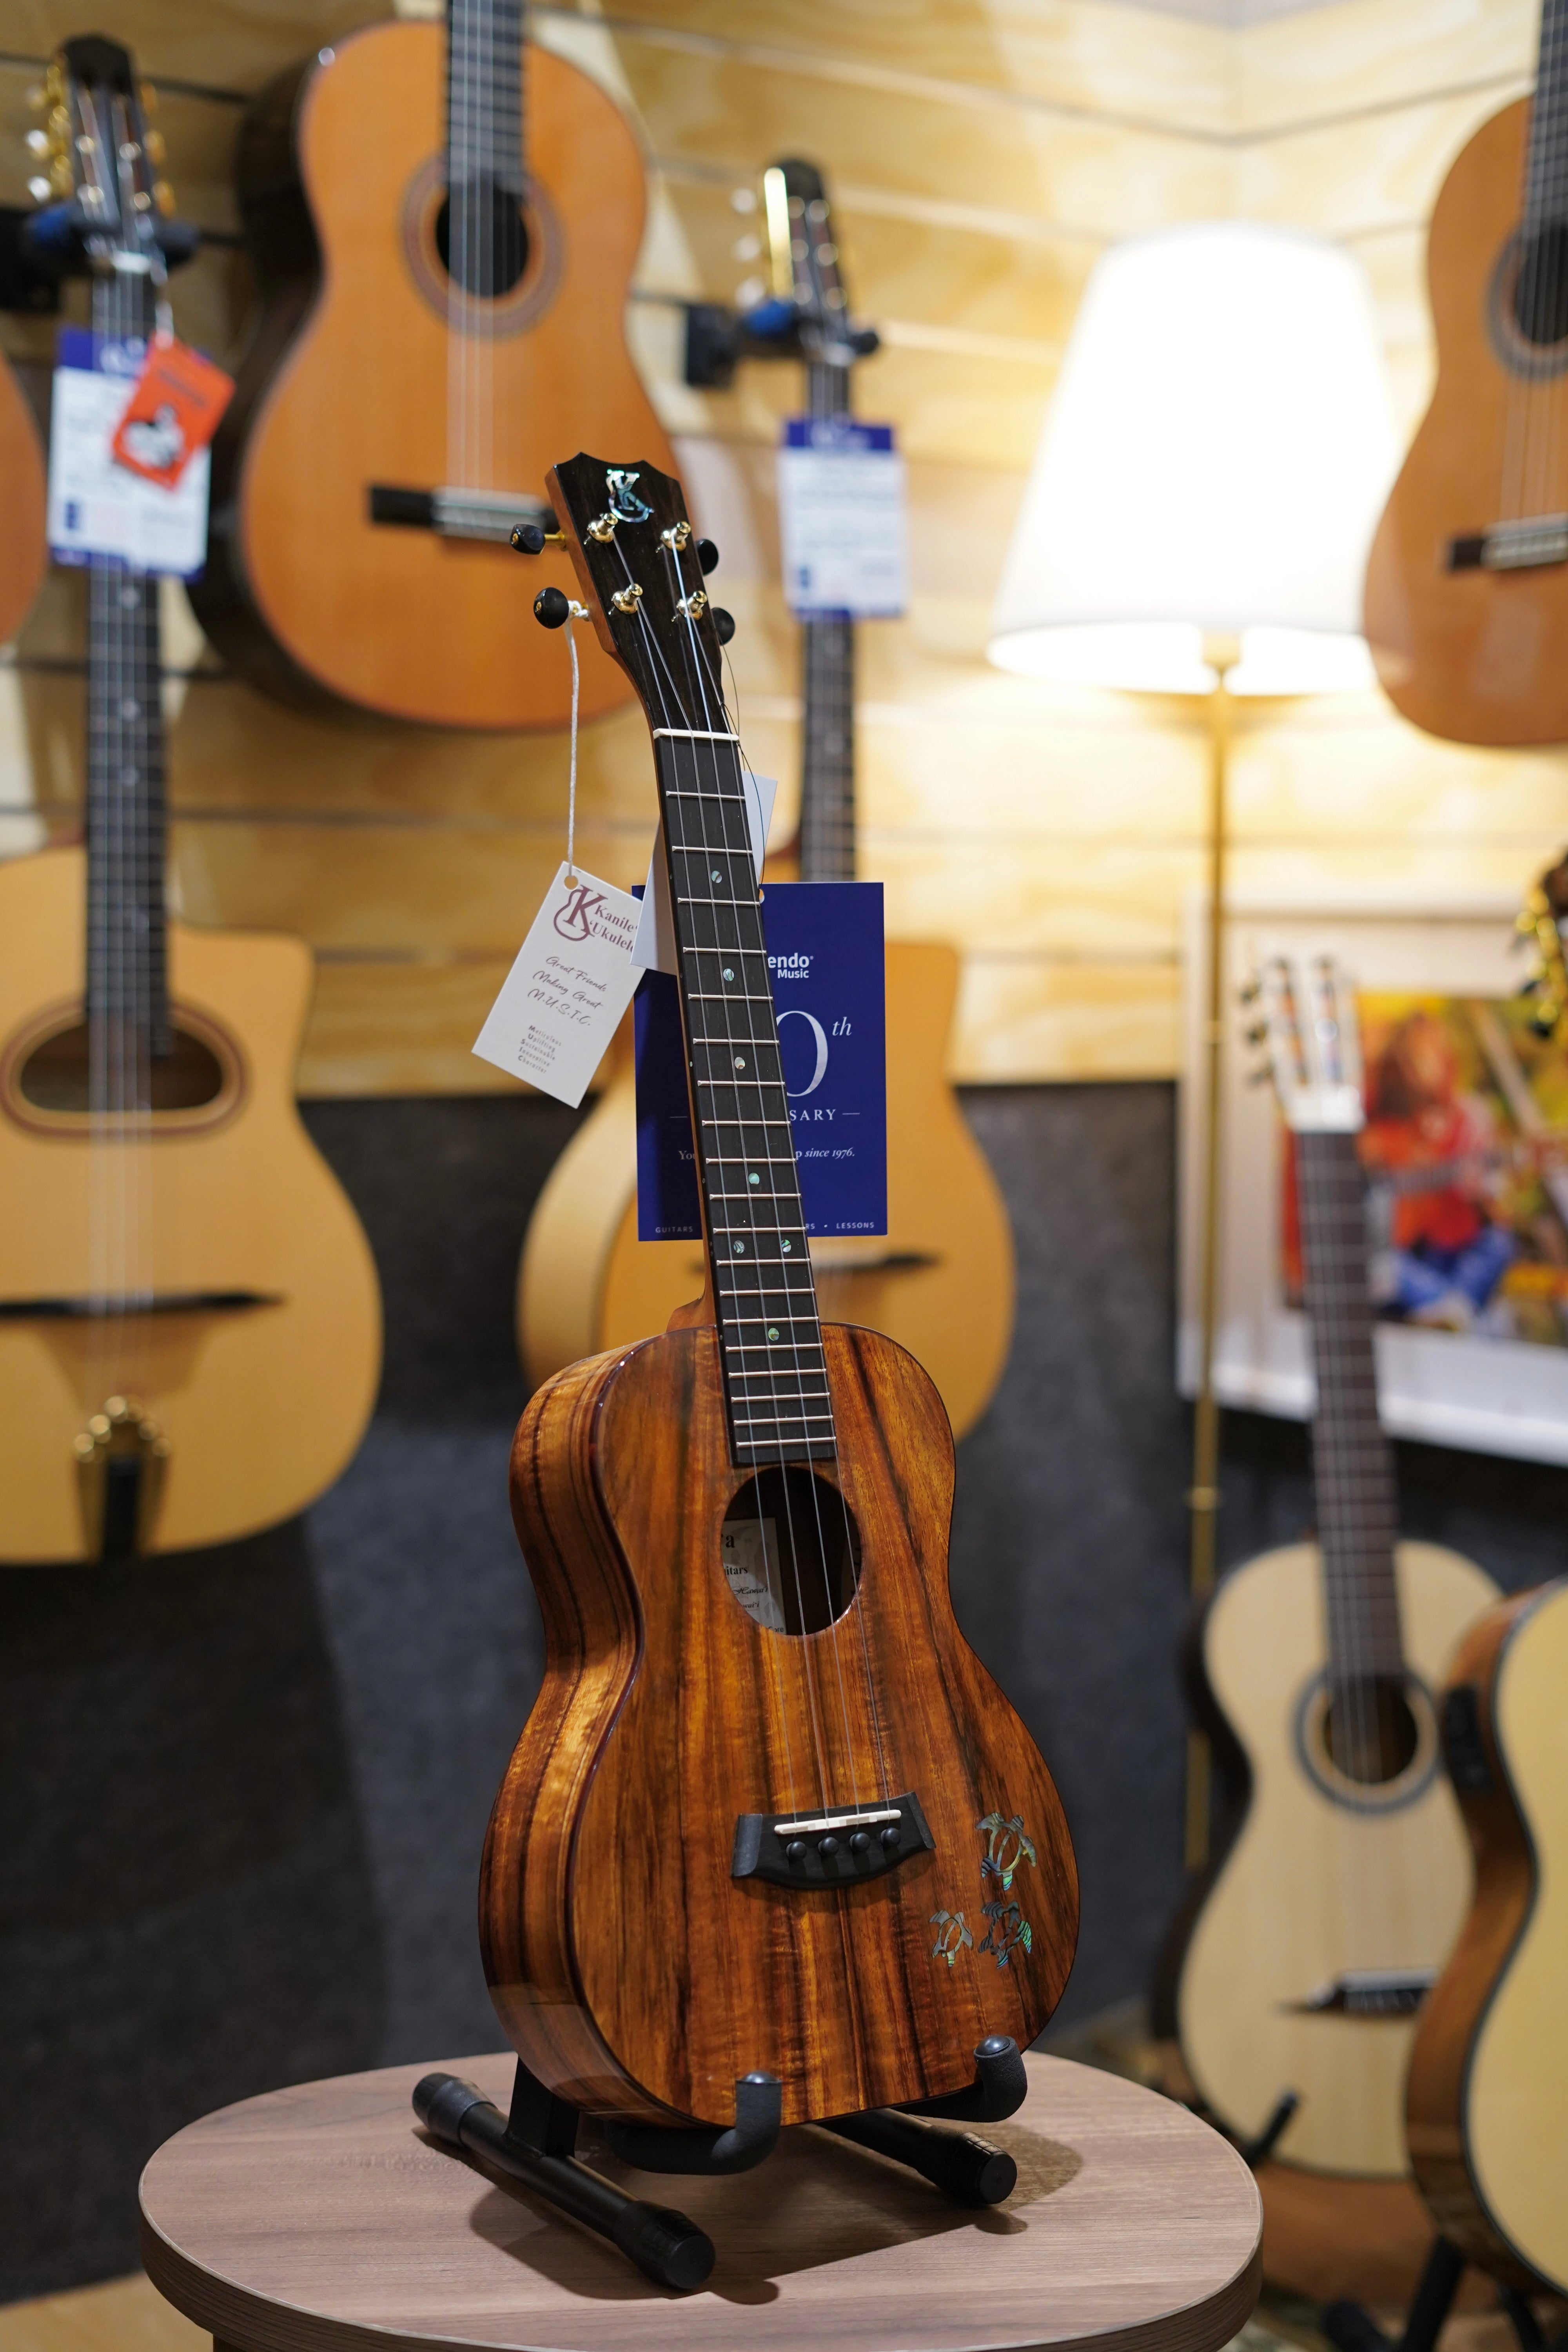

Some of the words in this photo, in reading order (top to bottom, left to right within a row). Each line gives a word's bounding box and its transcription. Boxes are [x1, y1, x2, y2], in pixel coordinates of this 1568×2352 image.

[533, 971, 568, 995] Making
[572, 991, 603, 1009] Great
[546, 956, 576, 974] Great
[576, 970, 607, 991] Friends
[778, 969, 809, 978] Music
[528, 989, 590, 1025] M.U.S.I.C.
[804, 1148, 829, 1158] since
[832, 1147, 855, 1160] 1976.
